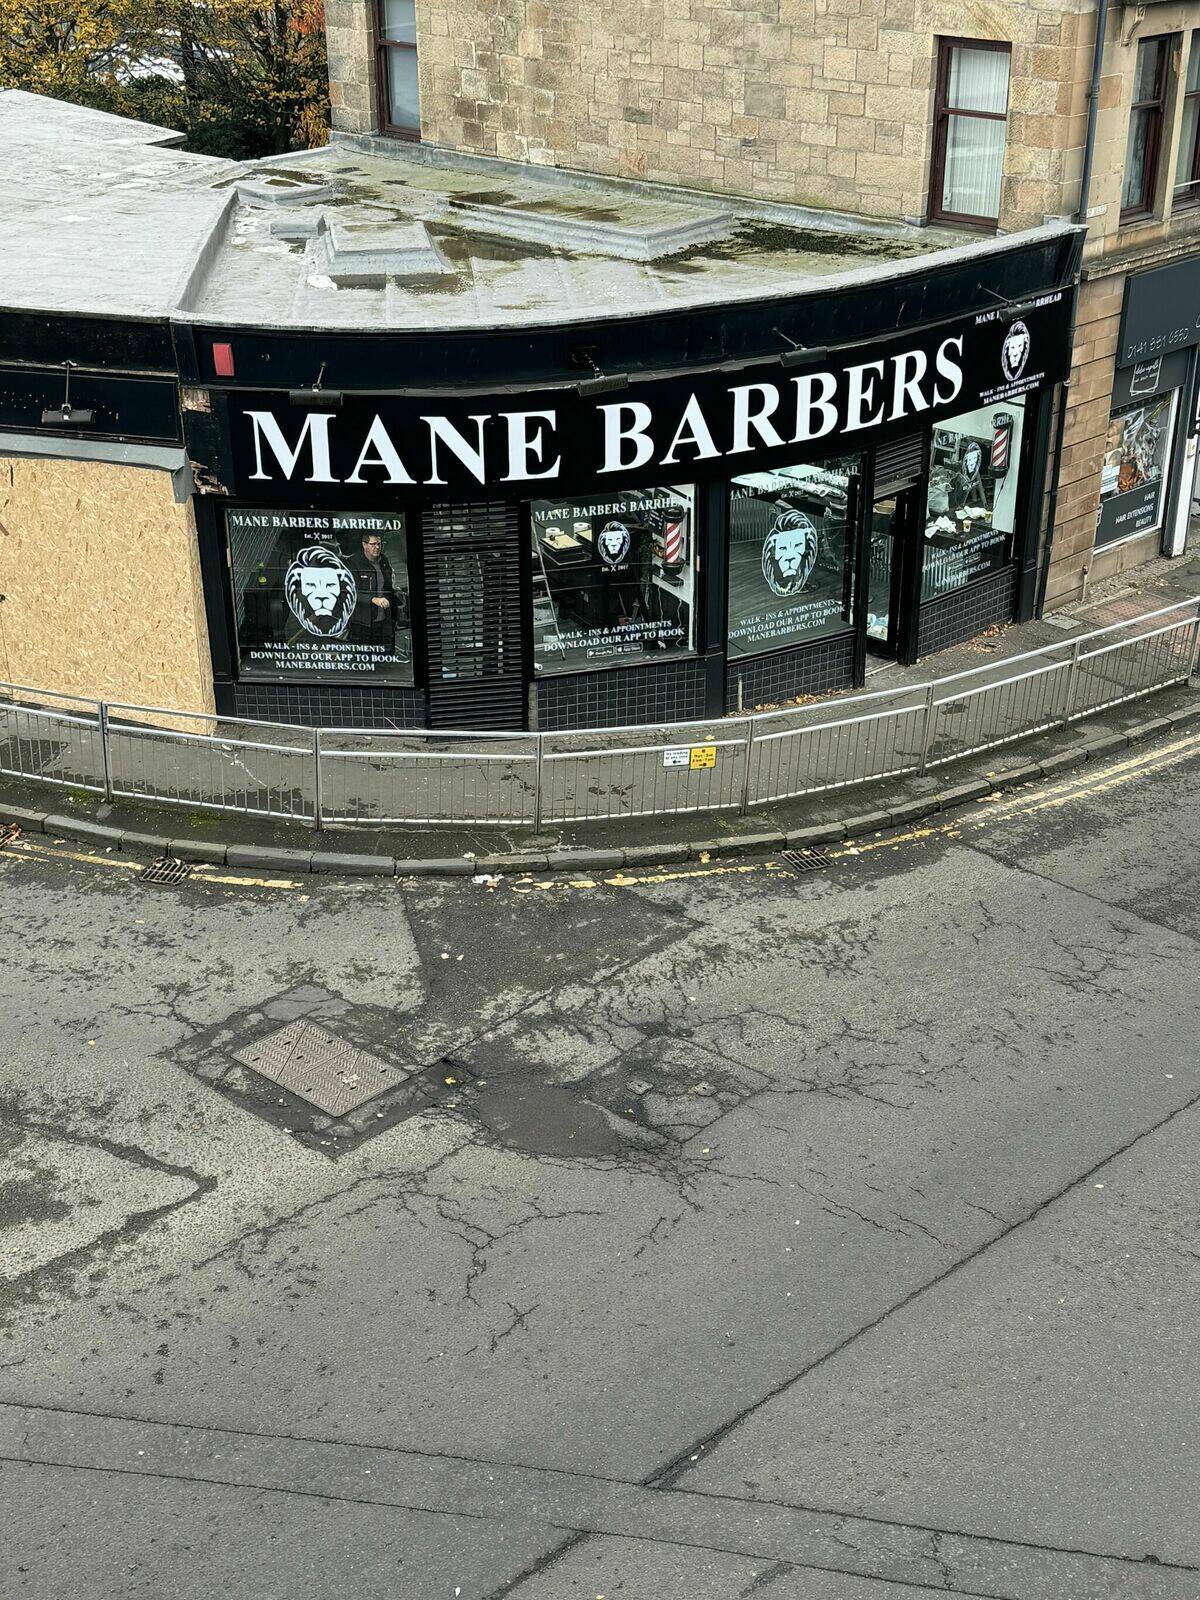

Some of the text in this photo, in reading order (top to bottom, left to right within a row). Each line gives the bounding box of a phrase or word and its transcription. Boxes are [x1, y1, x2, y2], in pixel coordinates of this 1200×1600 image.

[975, 310, 996, 325] MANE
[242, 334, 964, 485] MANE BARBERS
[1143, 491, 1156, 502] HAIR
[535, 497, 681, 522] MANE BARBERS BARRHE
[1115, 503, 1155, 525] HAIR EXTENSIONS
[232, 515, 401, 531] MANE BARBERS BARRHEAD
[1135, 515, 1153, 528] BEAUTY
[969, 543, 981, 554] APP
[981, 540, 990, 550] TO
[989, 533, 1006, 546] BOOK
[728, 605, 845, 640] DOWNLOAD OUR APP TO BOOK
[739, 617, 761, 627] WALK
[765, 612, 777, 621] INS
[777, 610, 783, 618] &
[784, 598, 835, 617] APPOINTMENTS
[544, 627, 685, 652] DOWNLOAD OUR APP TO BOOK
[558, 630, 583, 640] WALK
[588, 628, 602, 637] INS
[603, 627, 609, 635] &
[611, 619, 672, 634] APPOINTMENTS
[747, 618, 826, 643] MANEBARBERS.COM
[250, 651, 399, 663] DOWNLOAD OUR APP TO BOOK
[264, 642, 290, 651] WALK
[296, 643, 310, 651] INS
[311, 643, 319, 651] &
[320, 644, 386, 653] APPOINTMENTS
[275, 661, 375, 671] MANEBARBERS.COM
